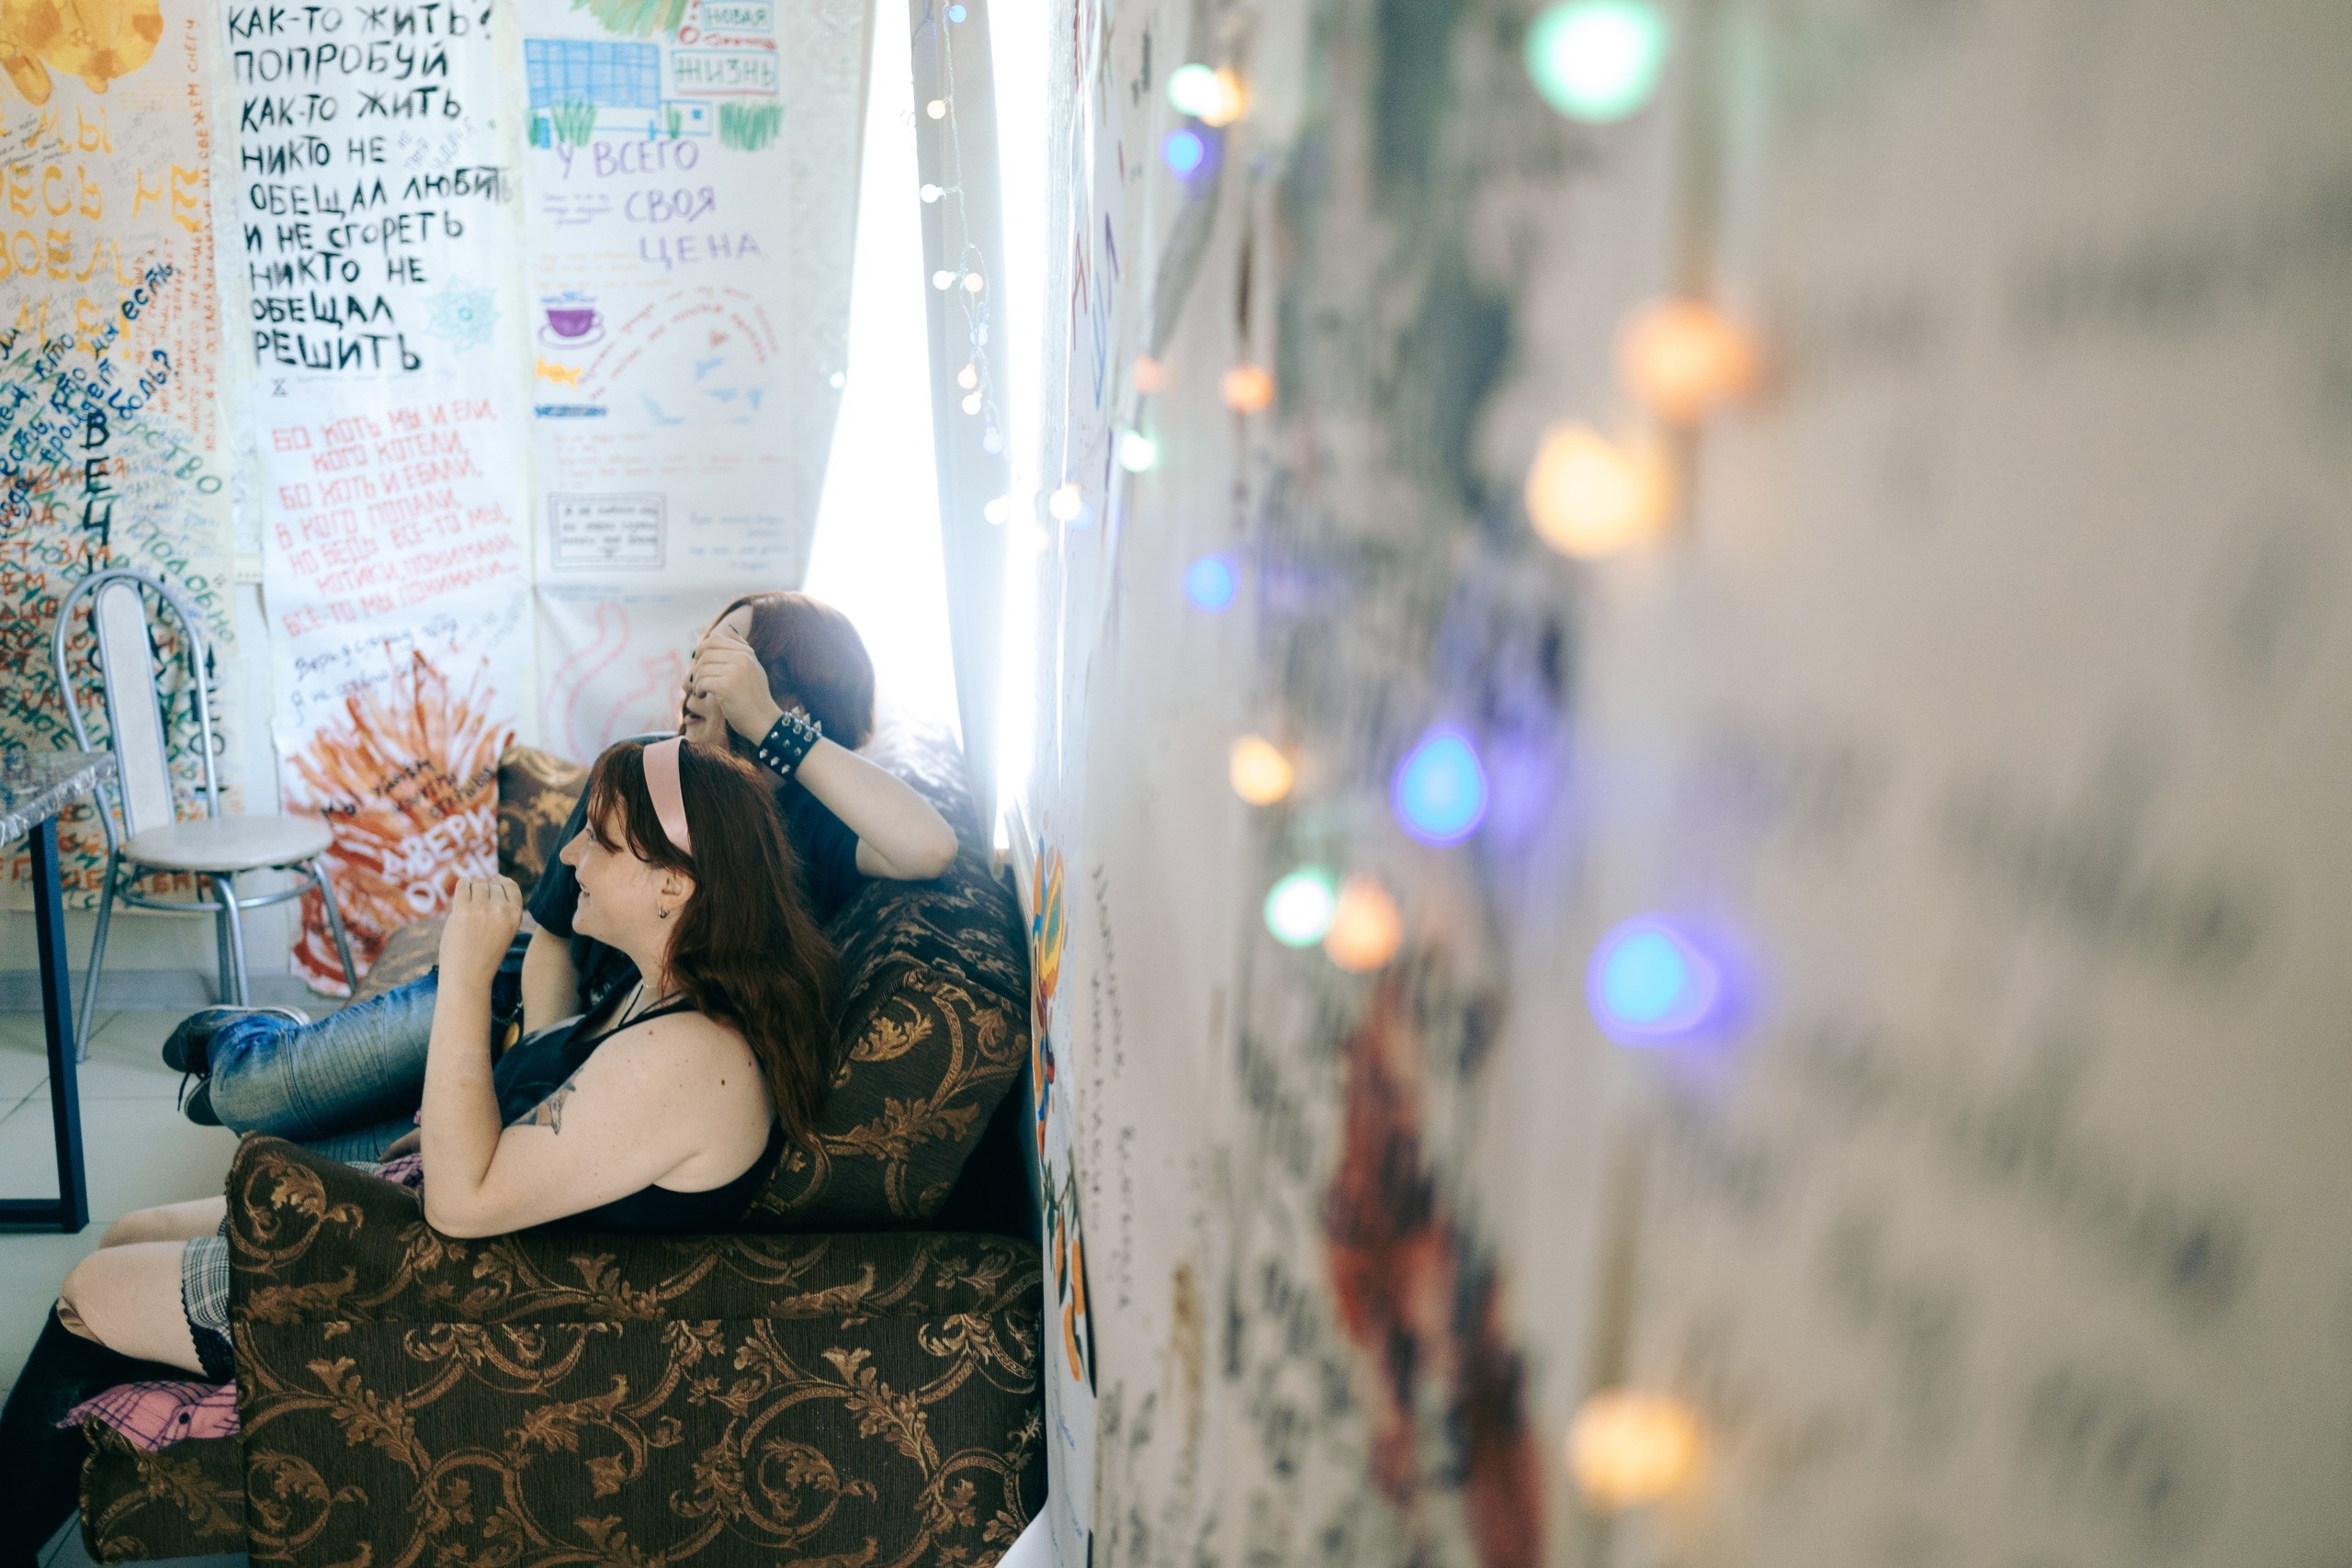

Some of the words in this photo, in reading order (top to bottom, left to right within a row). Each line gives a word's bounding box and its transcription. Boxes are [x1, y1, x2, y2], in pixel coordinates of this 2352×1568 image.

[229, 6, 344, 43] КАК-ТО
[233, 40, 448, 85] ПОПРОБУЙ
[241, 93, 338, 133] КАК-ТО
[356, 85, 462, 121] ЖИТЬ
[241, 135, 331, 177] НИКТО
[347, 136, 388, 166] НЕ
[555, 141, 575, 181] У
[593, 140, 699, 178] ВСЕГО
[250, 175, 389, 220] ОБЕЩАЛ
[624, 186, 717, 224] СВОЯ
[243, 221, 263, 254] И
[276, 221, 314, 254] НЕ
[327, 208, 465, 257] СГОРЕТЬ
[639, 232, 762, 272] ЦЕНА
[249, 250, 360, 291] НИКТО
[387, 255, 428, 285] НЕ
[250, 289, 395, 331] ОБЕЩАЛ
[253, 328, 424, 371] РЕШИТЬ
[379, 469, 401, 495] И
[299, 508, 360, 543] КОГО
